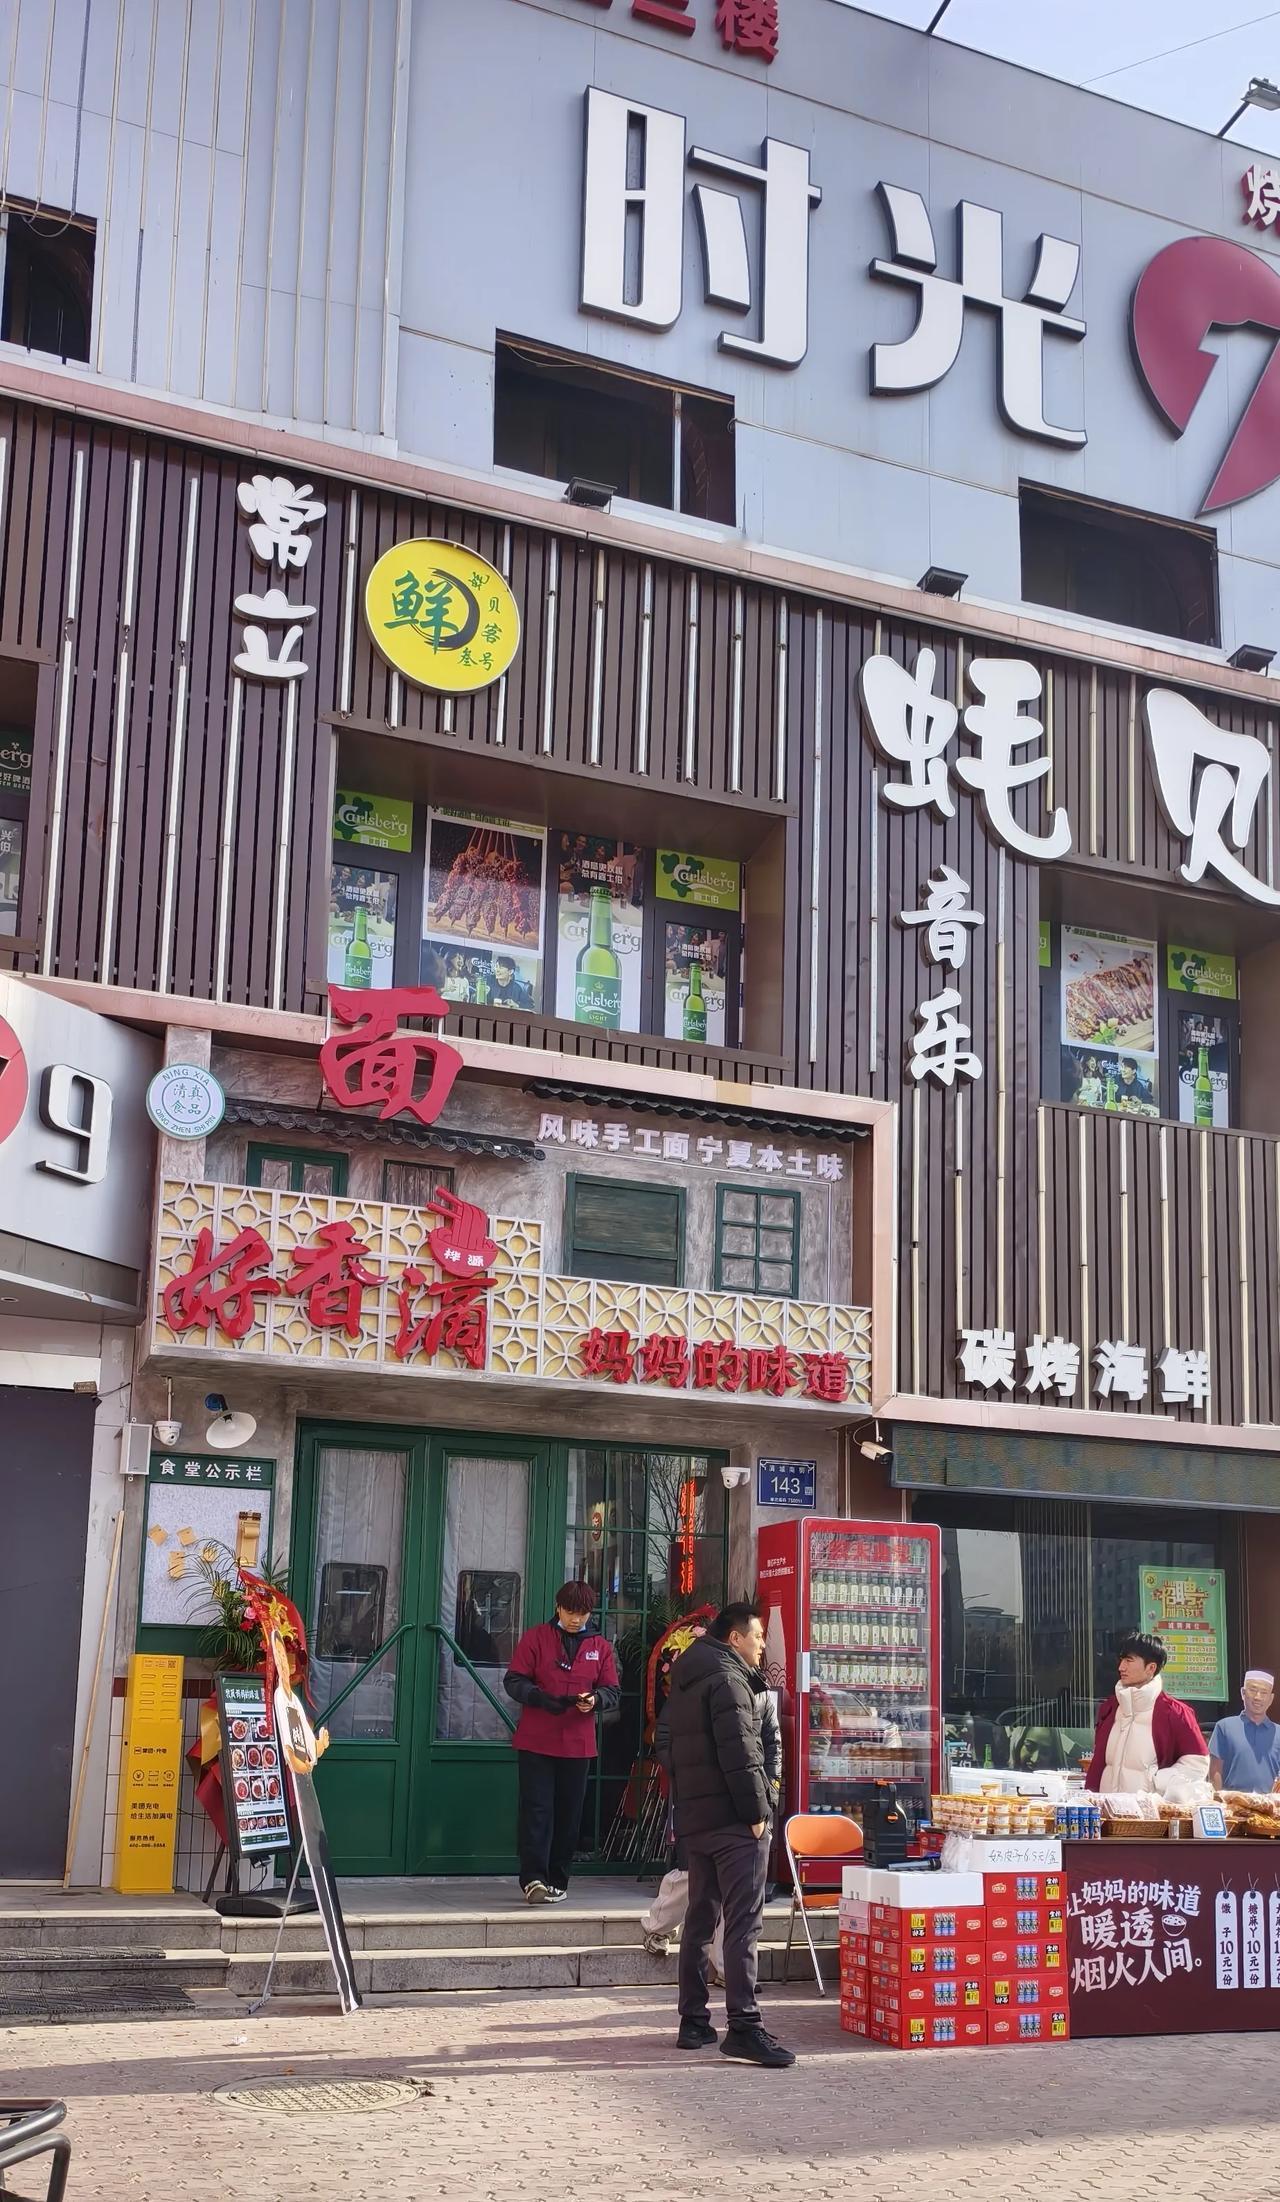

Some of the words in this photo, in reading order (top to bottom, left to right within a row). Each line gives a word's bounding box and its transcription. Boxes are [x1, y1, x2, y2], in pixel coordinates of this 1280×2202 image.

[581, 85, 1087, 448] 时光
[233, 475, 326, 678] 常立
[384, 570, 459, 655] 鲜
[339, 804, 408, 836] Carlsberg
[673, 863, 735, 892] Carlsberg
[900, 864, 985, 1086] 音乐
[1182, 961, 1232, 987] Carlsberg
[163, 1068, 189, 1081] NING
[193, 1071, 210, 1087] XIA
[319, 985, 463, 1124] 面
[171, 1099, 201, 1115] 食品
[173, 1083, 203, 1100] 清真
[38, 1063, 113, 1186] 9
[155, 1108, 170, 1126] QING
[170, 1123, 191, 1134] ZHEN
[194, 1123, 206, 1133] SHI
[205, 1114, 217, 1127] PIN
[163, 1219, 499, 1371] 好香滴
[580, 1326, 850, 1402] 妈妈的味道
[955, 1327, 1211, 1409] 碳烤海鲜
[159, 1458, 262, 1482] 食堂公示栏
[770, 1476, 801, 1495] 143
[1081, 1908, 1156, 1950] 暖透
[1070, 1938, 1202, 1995] 烟火人间。
